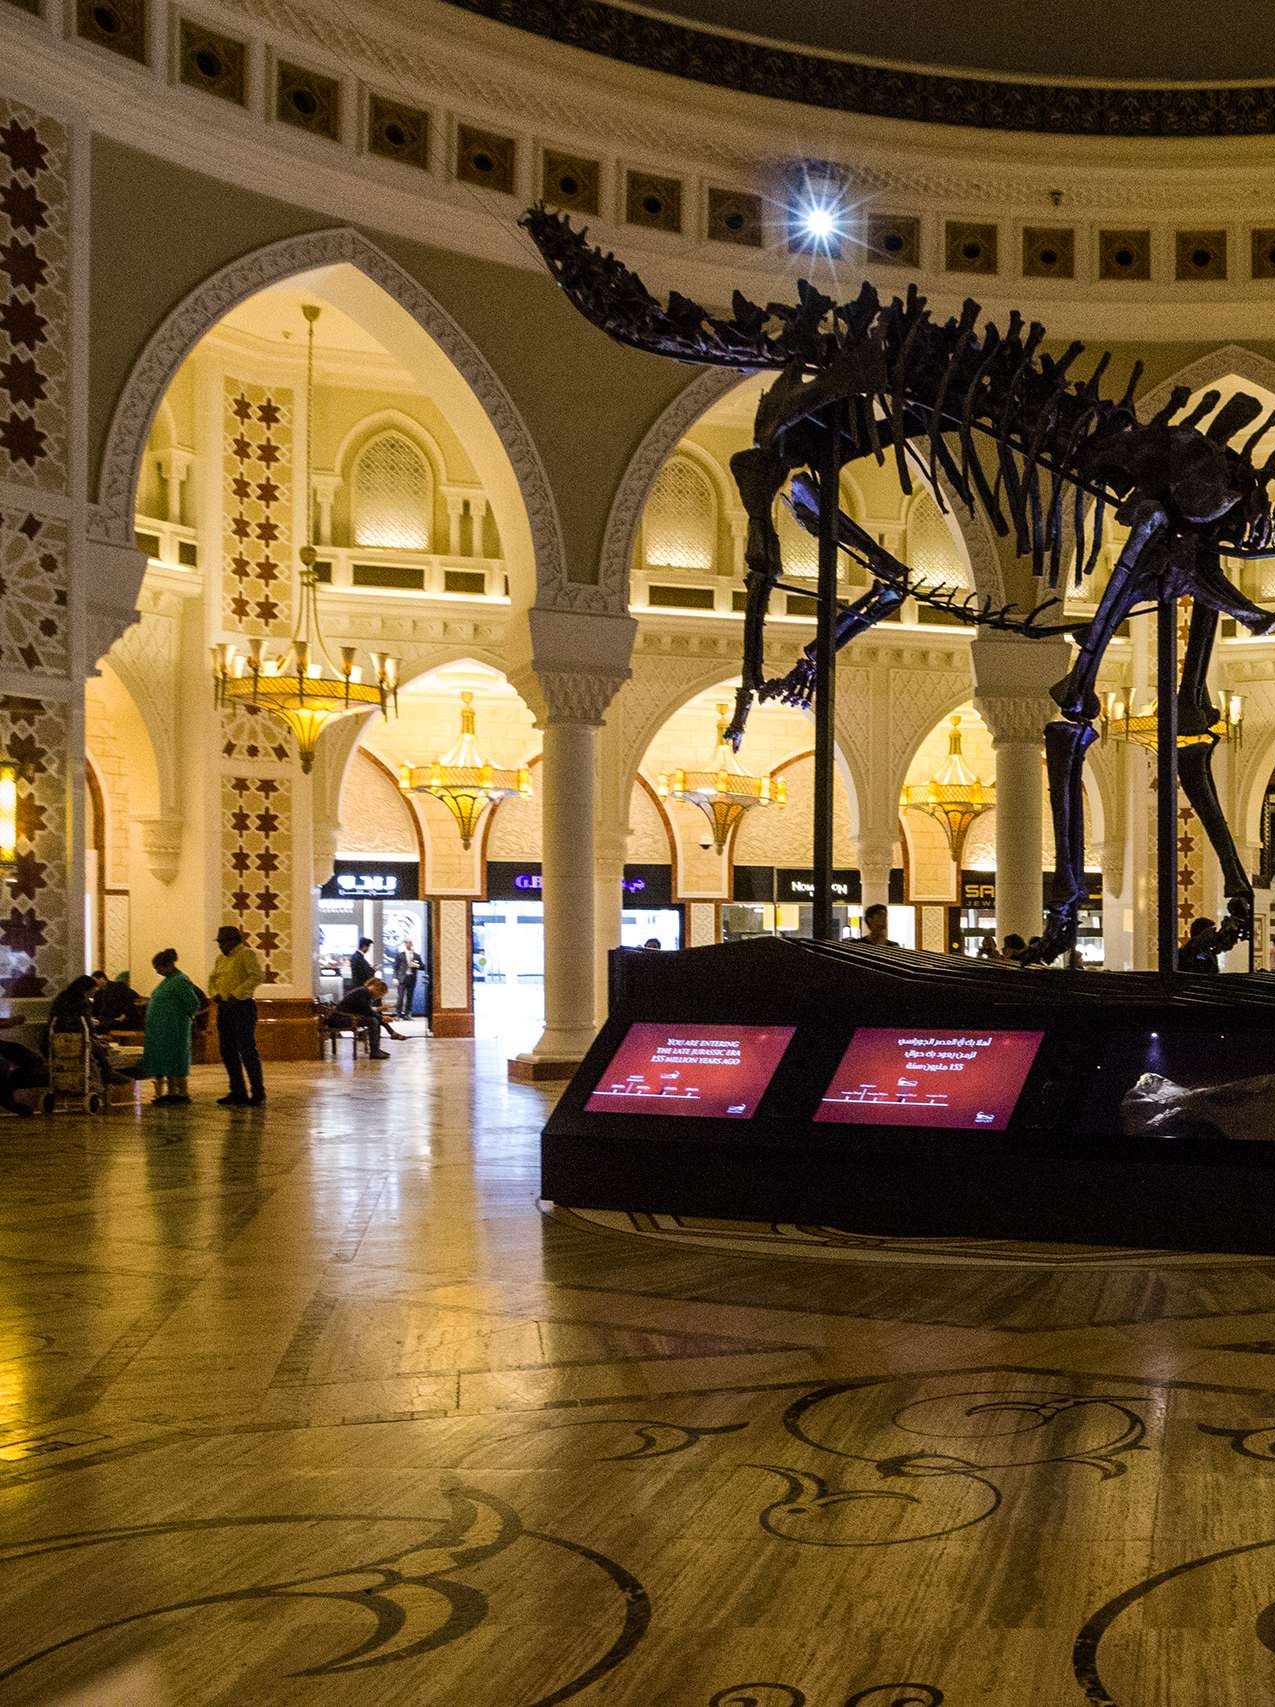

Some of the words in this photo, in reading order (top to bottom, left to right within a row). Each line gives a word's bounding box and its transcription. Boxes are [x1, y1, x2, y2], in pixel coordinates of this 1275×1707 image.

[667, 1038, 685, 1046] YOU
[700, 1039, 740, 1048] ENTERING
[672, 1047, 690, 1055] LATE
[691, 1048, 726, 1056] JURASSIC
[665, 1055, 699, 1064] MILLION
[699, 1056, 722, 1064] YEARS
[722, 1057, 741, 1065] AGO
